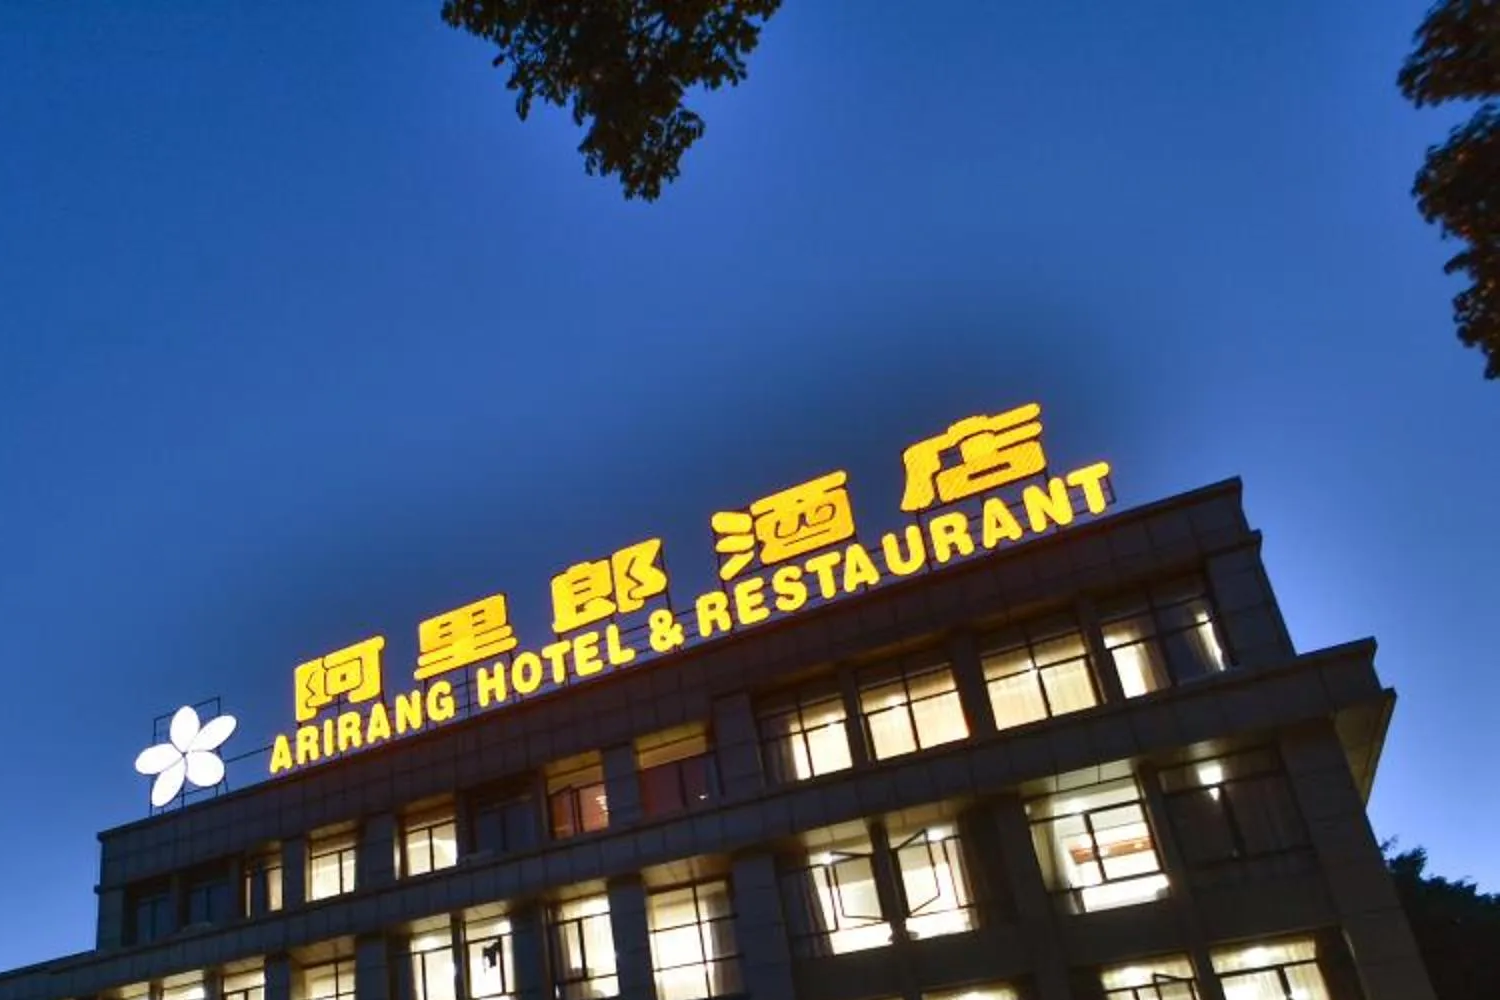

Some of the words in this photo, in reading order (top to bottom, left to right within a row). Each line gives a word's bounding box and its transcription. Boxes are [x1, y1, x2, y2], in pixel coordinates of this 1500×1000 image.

[269, 680, 455, 775] ARIRANG
[476, 624, 635, 707] HOTEL
[648, 609, 684, 652] &
[695, 461, 1110, 638] RESTAURANT
[294, 402, 1047, 722] 阿里郎酒店
